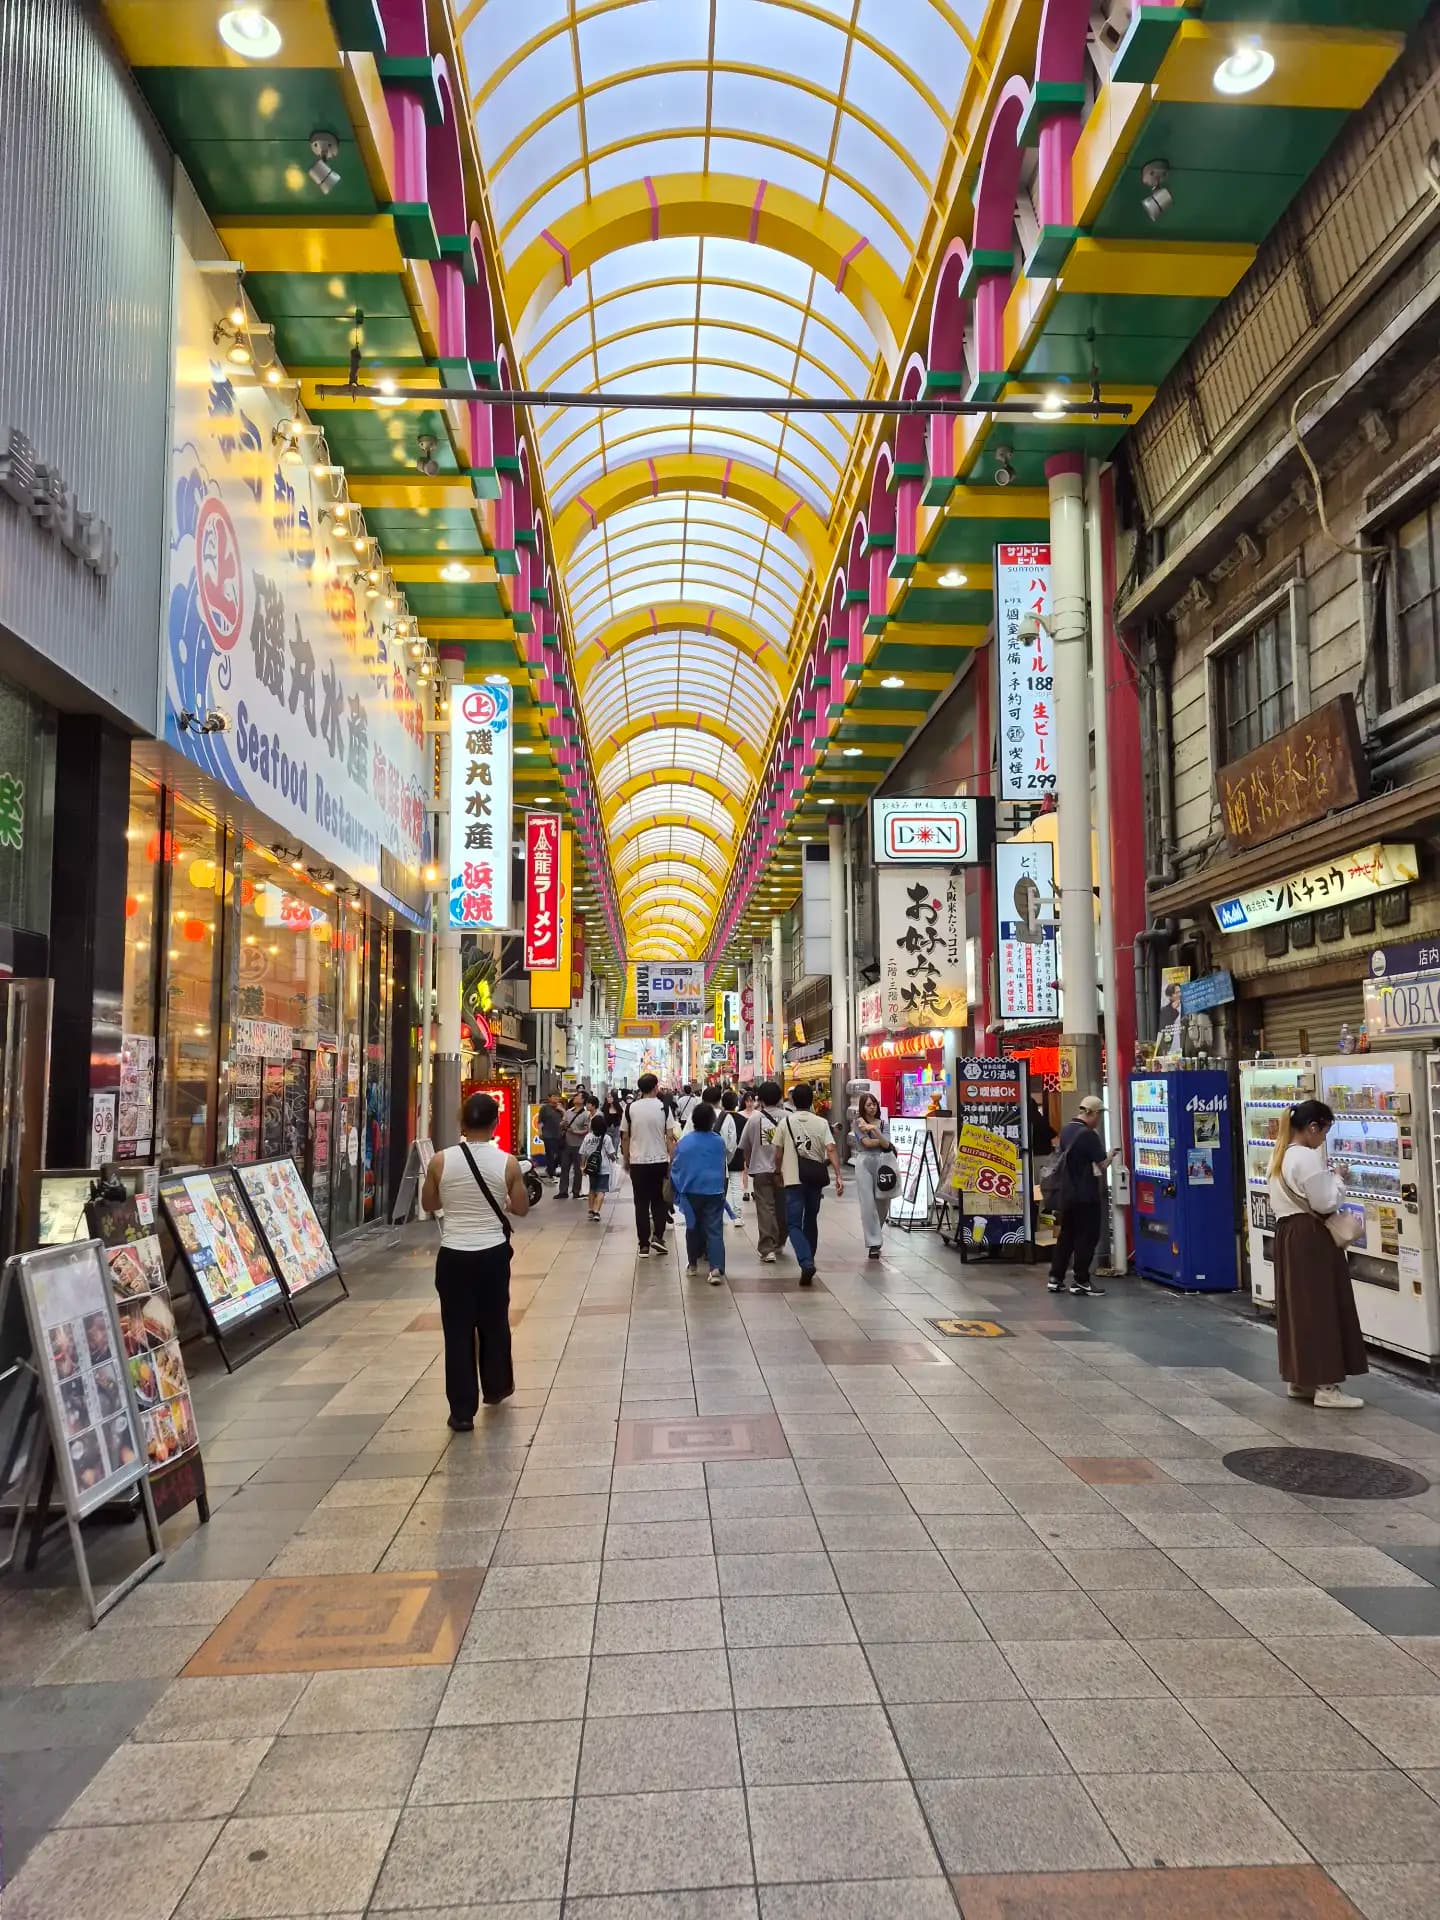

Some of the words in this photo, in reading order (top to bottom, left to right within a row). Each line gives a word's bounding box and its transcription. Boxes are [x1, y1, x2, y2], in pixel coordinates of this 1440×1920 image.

[1007, 547, 1047, 556] サントリー
[1018, 557, 1037, 565] ビール
[1029, 577, 1049, 673] ハイール
[250, 569, 369, 793] 磯丸水産
[1026, 676, 1054, 691] 188
[1032, 701, 1050, 772] 生ビール
[236, 699, 308, 815] Seafood
[315, 772, 381, 866] Restaurant
[464, 728, 493, 850] 磯丸水産
[1027, 774, 1057, 789] 299
[463, 861, 494, 922] 浜焼
[533, 826, 553, 947] 金龍ラーメン
[1266, 867, 1345, 912] シバチョウ
[652, 978, 701, 996] EDION
[1382, 984, 1440, 1028] TOBA
[1186, 1094, 1228, 1112] Asahi
